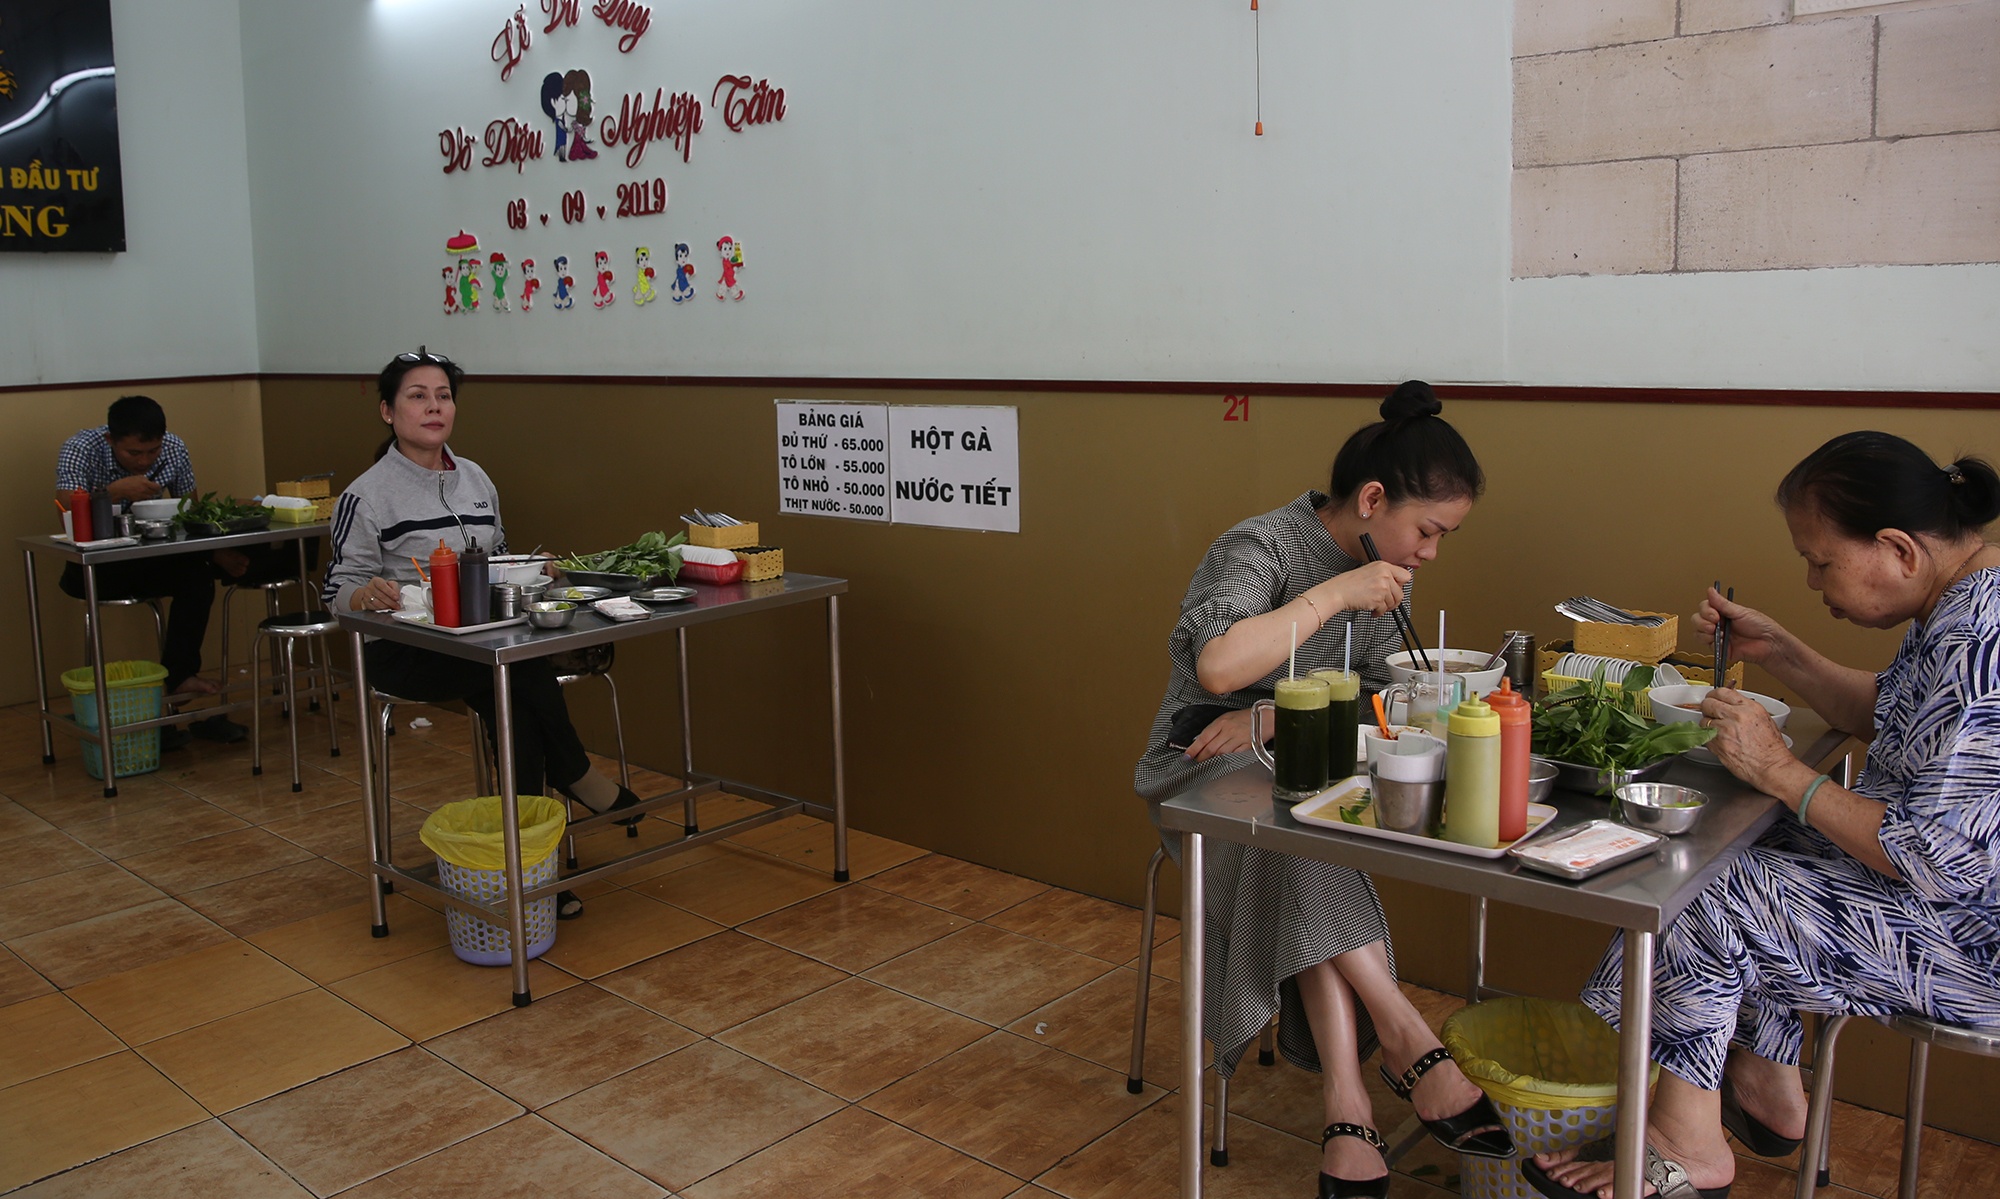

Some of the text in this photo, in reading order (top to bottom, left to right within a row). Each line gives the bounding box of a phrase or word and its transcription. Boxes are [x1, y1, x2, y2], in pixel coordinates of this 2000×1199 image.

[482, 117, 544, 174] Diệu
[601, 87, 704, 168] Nghiệp
[10, 159, 61, 190] ĐẦU
[66, 166, 99, 191] TƯ
[507, 177, 667, 229] 03 09 2019
[799, 408, 864, 428] BẢNG GIÁ
[1223, 394, 1249, 421] 21
[782, 431, 798, 448] ĐỦ
[802, 433, 828, 449] THỨ
[841, 438, 884, 452] 65.000
[911, 425, 992, 455] HỘT GÀ
[781, 454, 797, 469] TÔ
[801, 454, 825, 471] LỚN
[843, 460, 885, 475] 55.000
[783, 475, 799, 490] TÔ
[803, 475, 829, 493] NHỎ
[843, 482, 885, 497] 50.000
[895, 477, 1012, 506] NƯỚC TIẾT
[785, 497, 809, 512] THỊT
[811, 498, 841, 512] NƯỚC
[849, 503, 884, 517] 50.000
